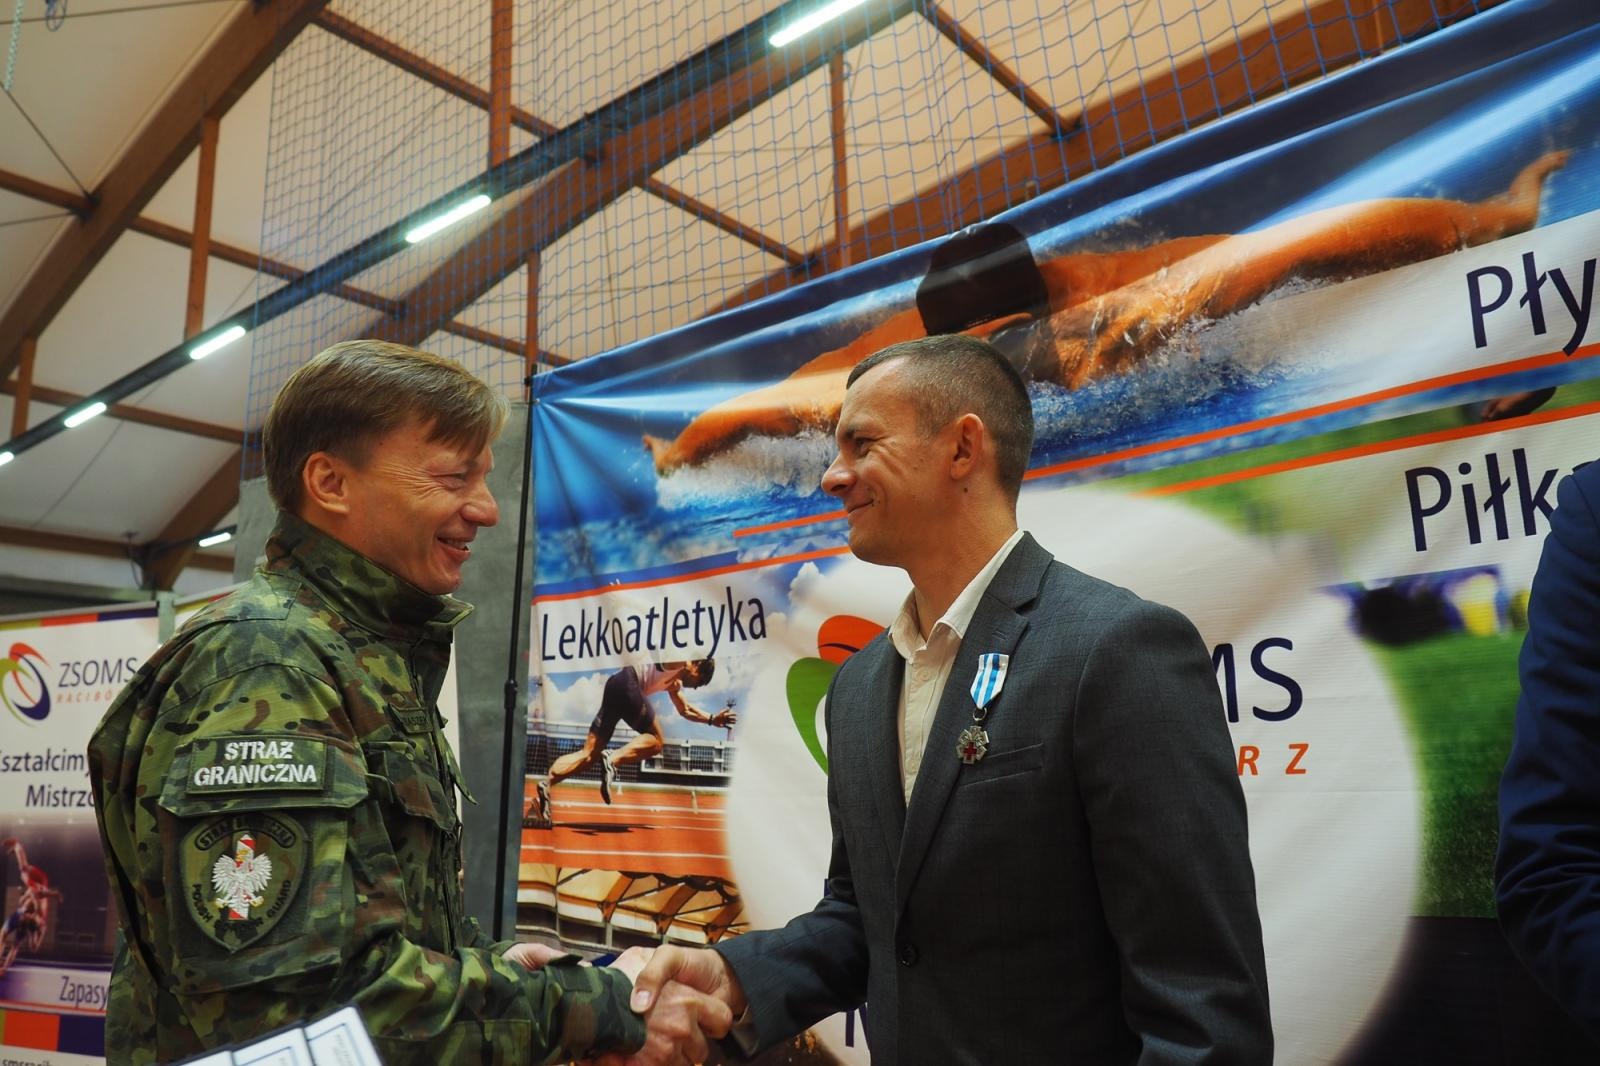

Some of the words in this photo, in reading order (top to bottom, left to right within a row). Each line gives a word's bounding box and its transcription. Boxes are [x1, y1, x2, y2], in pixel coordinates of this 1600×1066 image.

[1466, 251, 1598, 357] Pły
[1405, 448, 1597, 551] Piłk
[541, 586, 768, 661] Lekkoatletyka
[58, 657, 138, 688] ZSOMS
[0, 747, 91, 778] ształcim
[193, 763, 318, 787] GRANICZNA
[60, 976, 112, 1010] Zapasy
